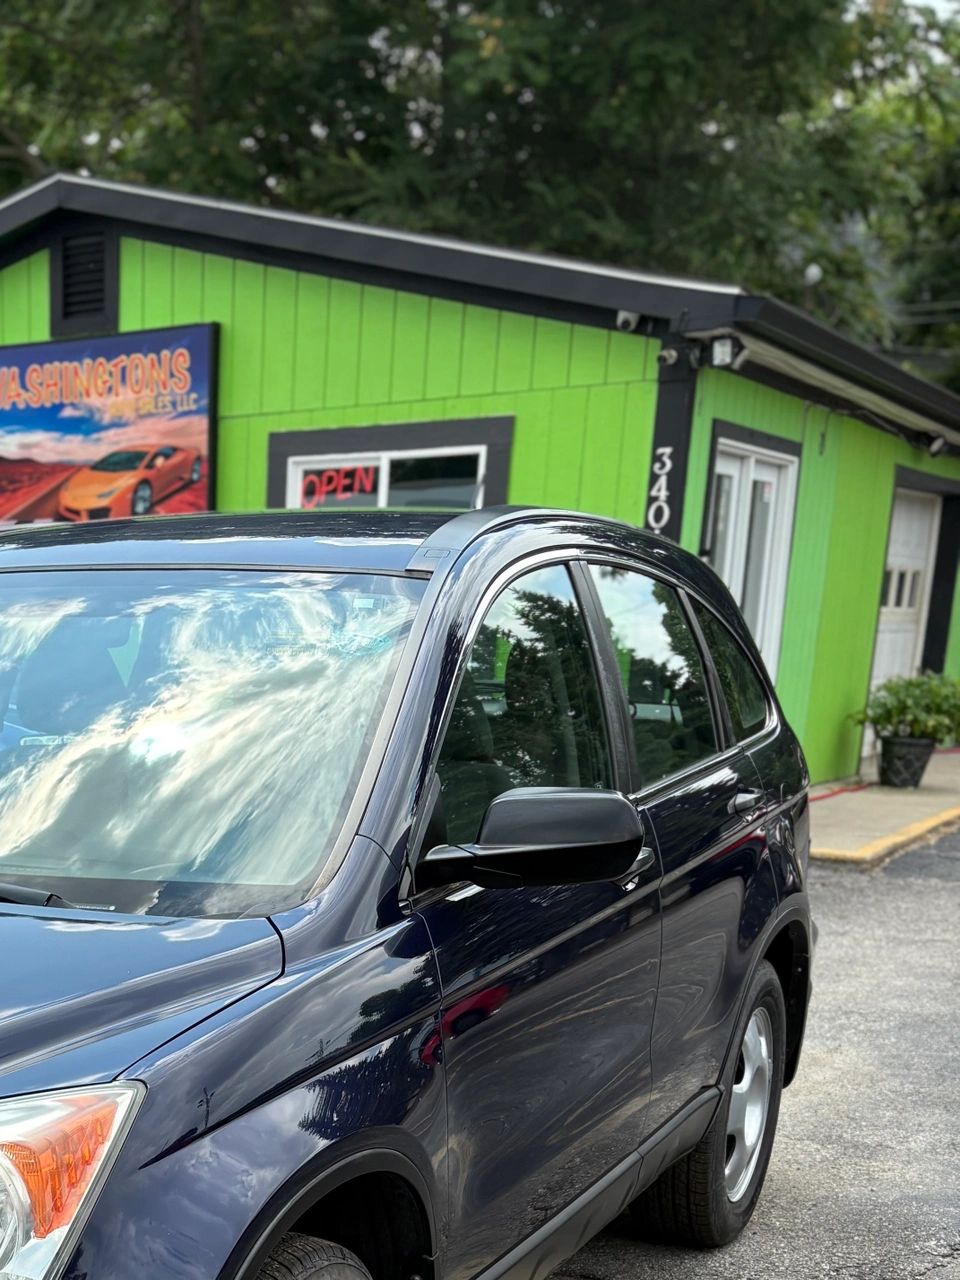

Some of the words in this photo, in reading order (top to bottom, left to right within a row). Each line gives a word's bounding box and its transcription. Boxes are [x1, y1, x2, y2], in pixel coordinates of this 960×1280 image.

[177, 392, 198, 412] LLC
[301, 465, 375, 510] OPEN
[647, 446, 674, 535] 340
